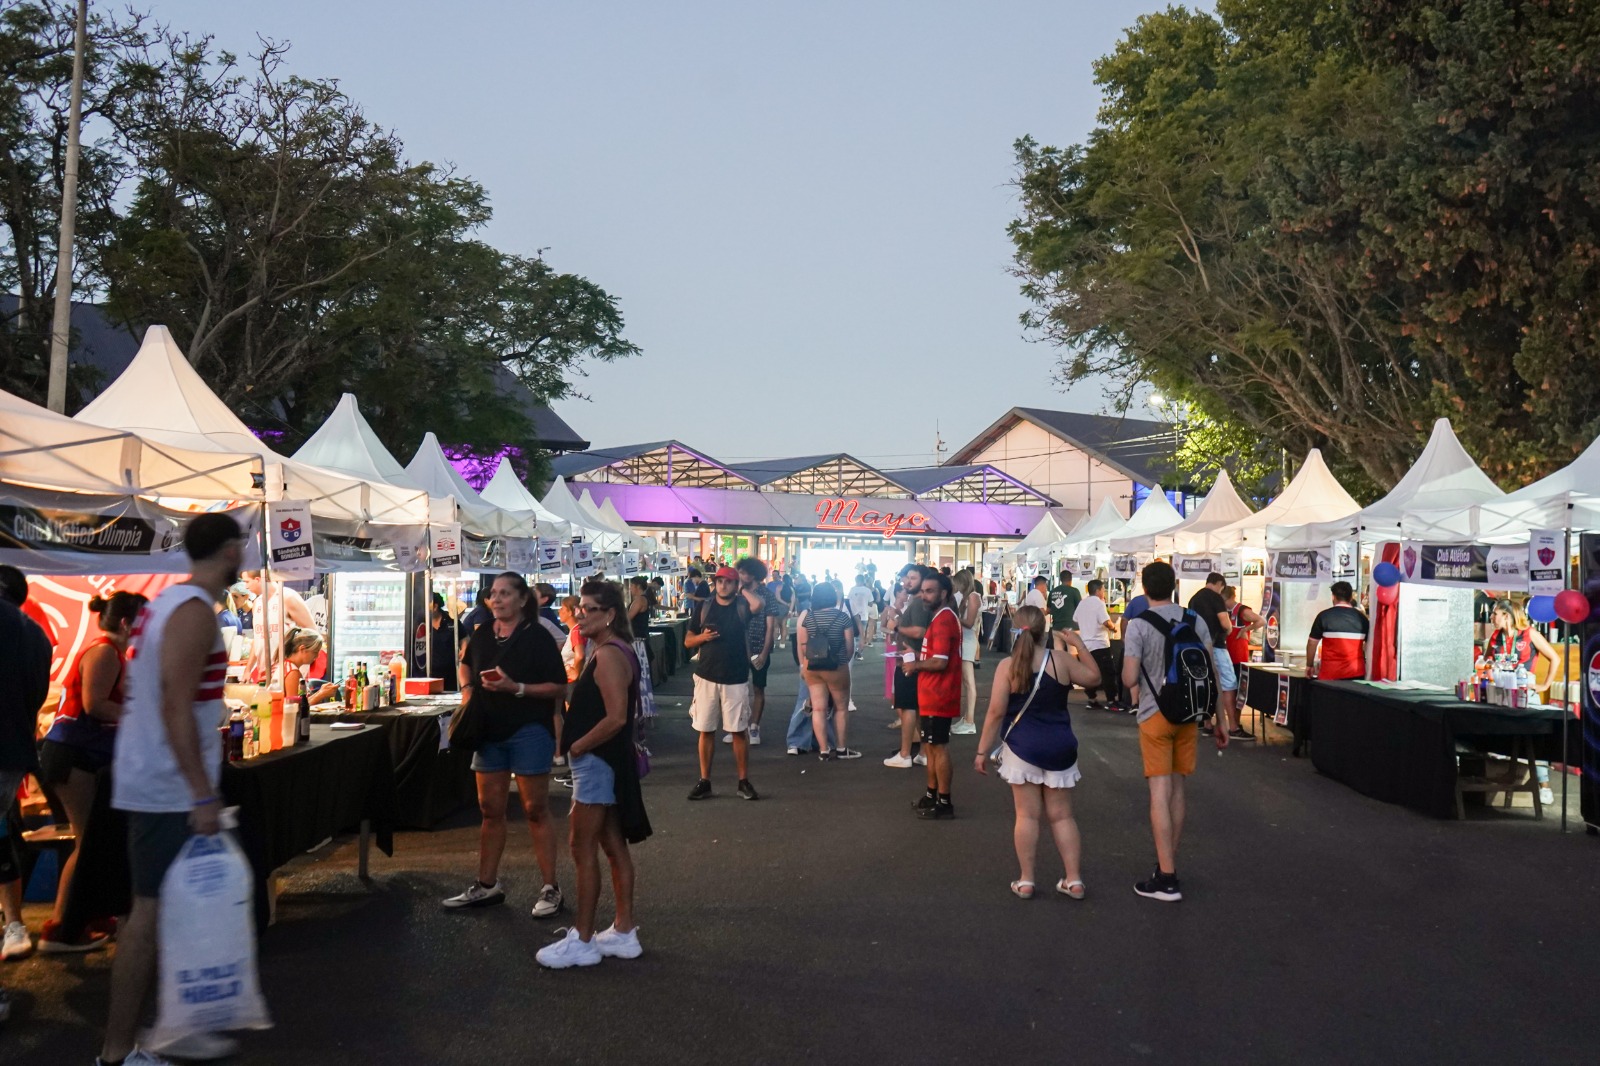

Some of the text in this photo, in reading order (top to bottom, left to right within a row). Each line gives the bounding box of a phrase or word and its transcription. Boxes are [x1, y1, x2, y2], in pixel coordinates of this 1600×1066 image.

[815, 498, 930, 539] Mayo
[13, 514, 46, 541] Club
[97, 522, 142, 552] Olimpia
[1437, 549, 1470, 562] Club Atlético
[1452, 564, 1460, 578] del
[1461, 565, 1471, 578] Sur
